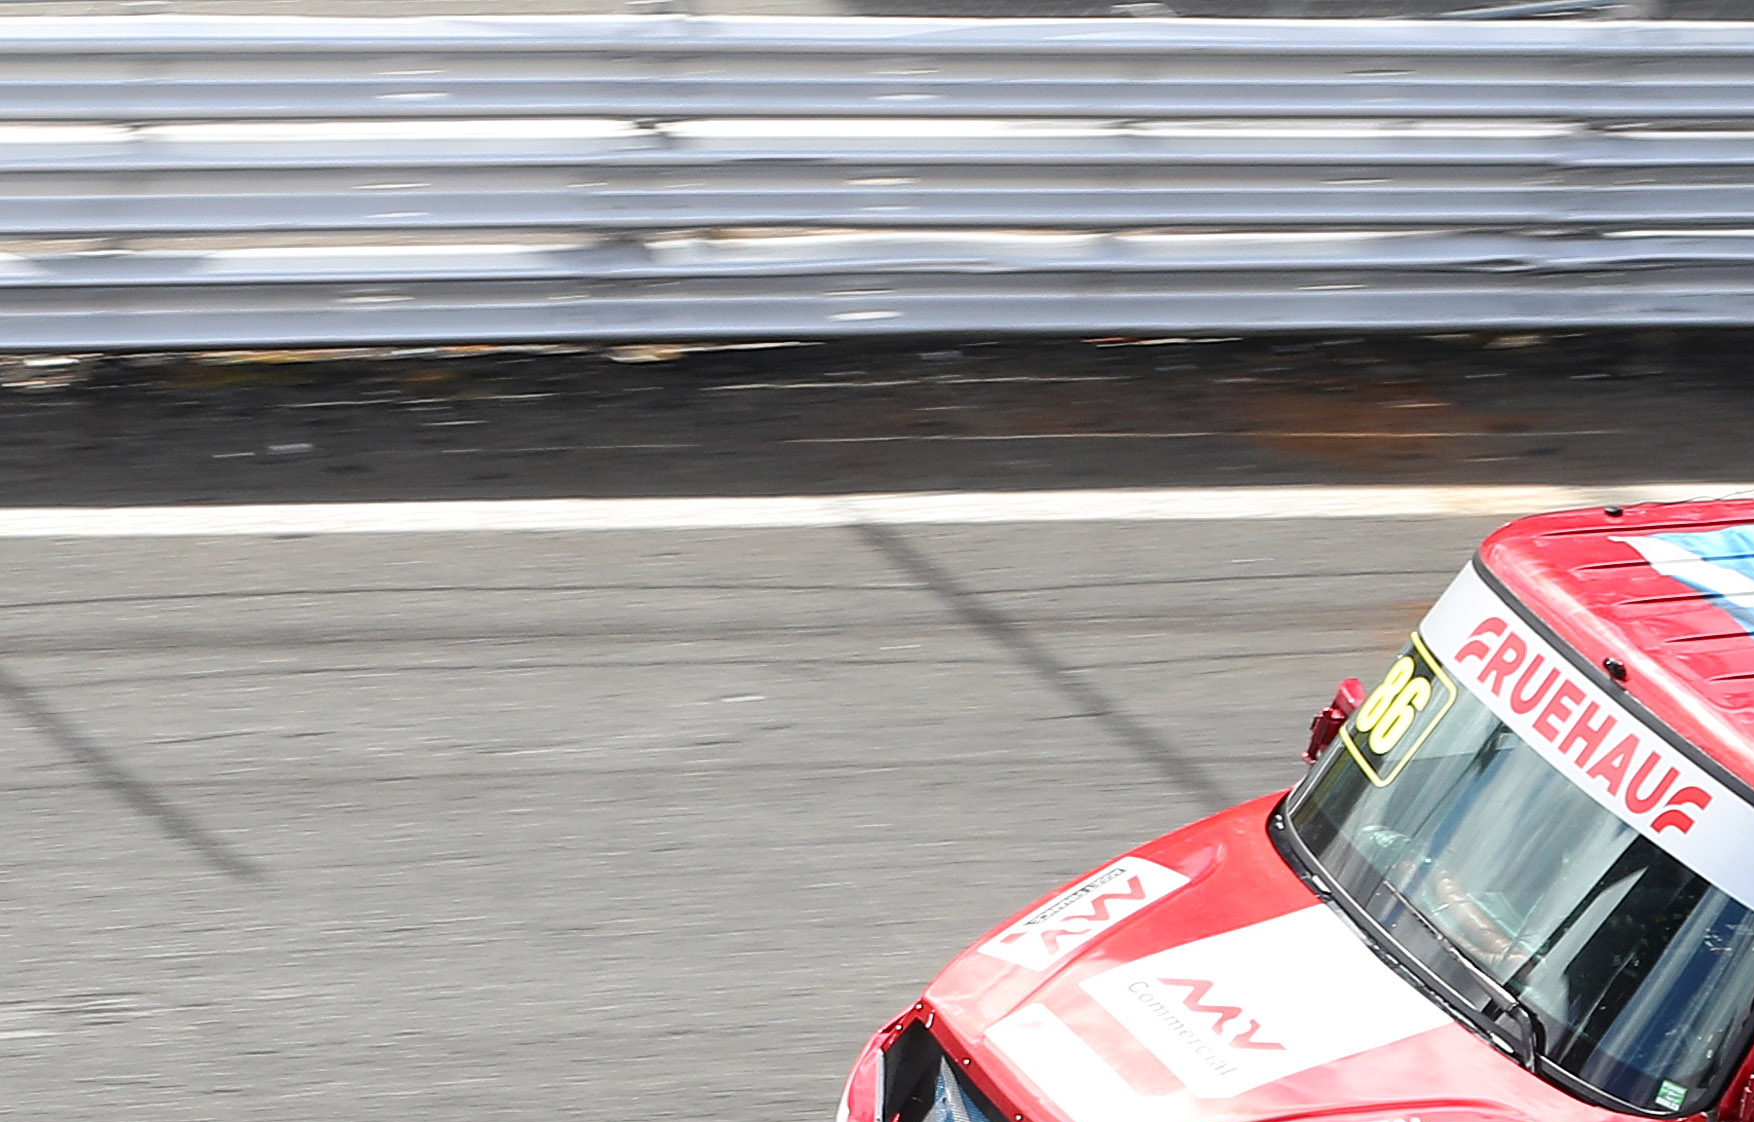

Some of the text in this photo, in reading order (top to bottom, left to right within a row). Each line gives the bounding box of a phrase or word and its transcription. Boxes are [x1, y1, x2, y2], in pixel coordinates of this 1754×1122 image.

[1356, 655, 1433, 755] 86
[1454, 616, 1713, 835] FRUEHAUF
[1127, 980, 1239, 1077] Commercial
